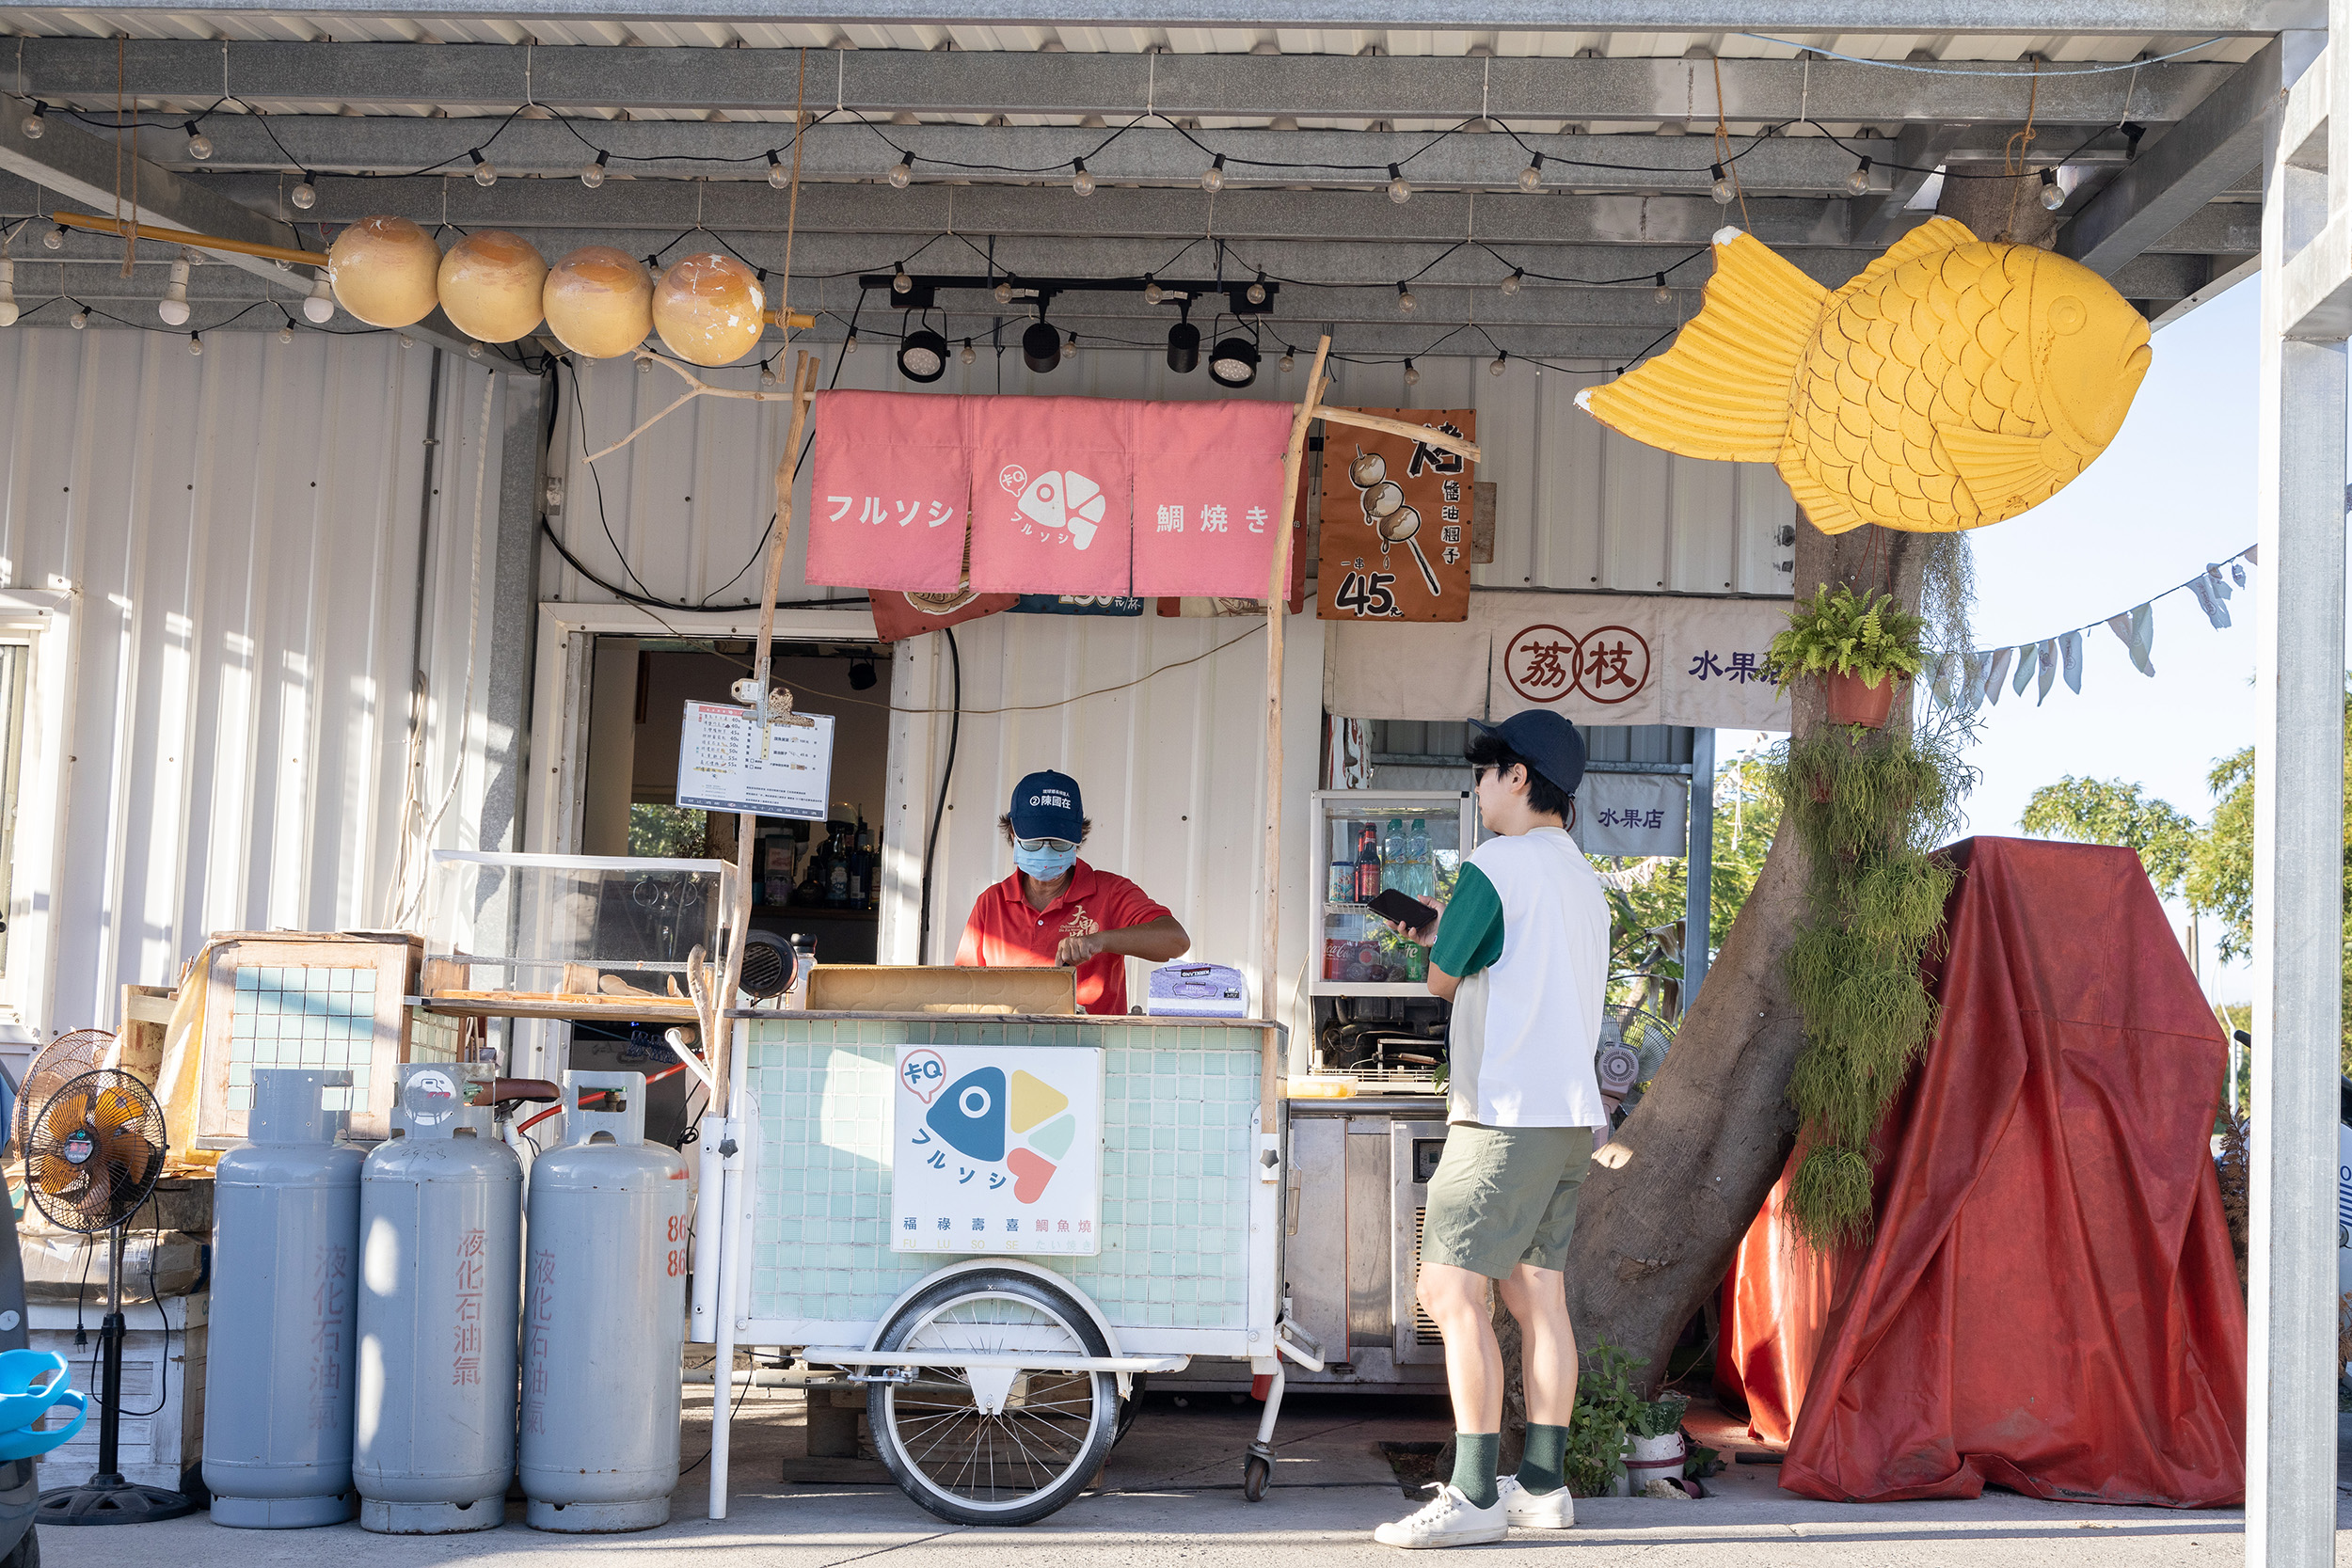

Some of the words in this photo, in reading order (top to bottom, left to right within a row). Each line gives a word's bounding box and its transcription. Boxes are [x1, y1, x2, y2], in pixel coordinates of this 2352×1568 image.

[827, 495, 954, 528] フルソシ
[1156, 503, 1269, 533] 鯛焼き
[1010, 511, 1069, 545] フルソシ
[1341, 556, 1364, 571] 一串
[1336, 571, 1395, 616] 45
[1519, 641, 1638, 689] 荔枝
[1041, 795, 1072, 810] 陳國在
[1597, 808, 1664, 829] 水果店
[905, 1060, 942, 1085] 卡Q
[912, 1128, 1007, 1190] フルソシ
[903, 1238, 917, 1249] FU
[937, 1239, 950, 1250] LU
[971, 1239, 985, 1250] SO
[1006, 1240, 1019, 1250] SE
[453, 1227, 485, 1386] 液化石油氣
